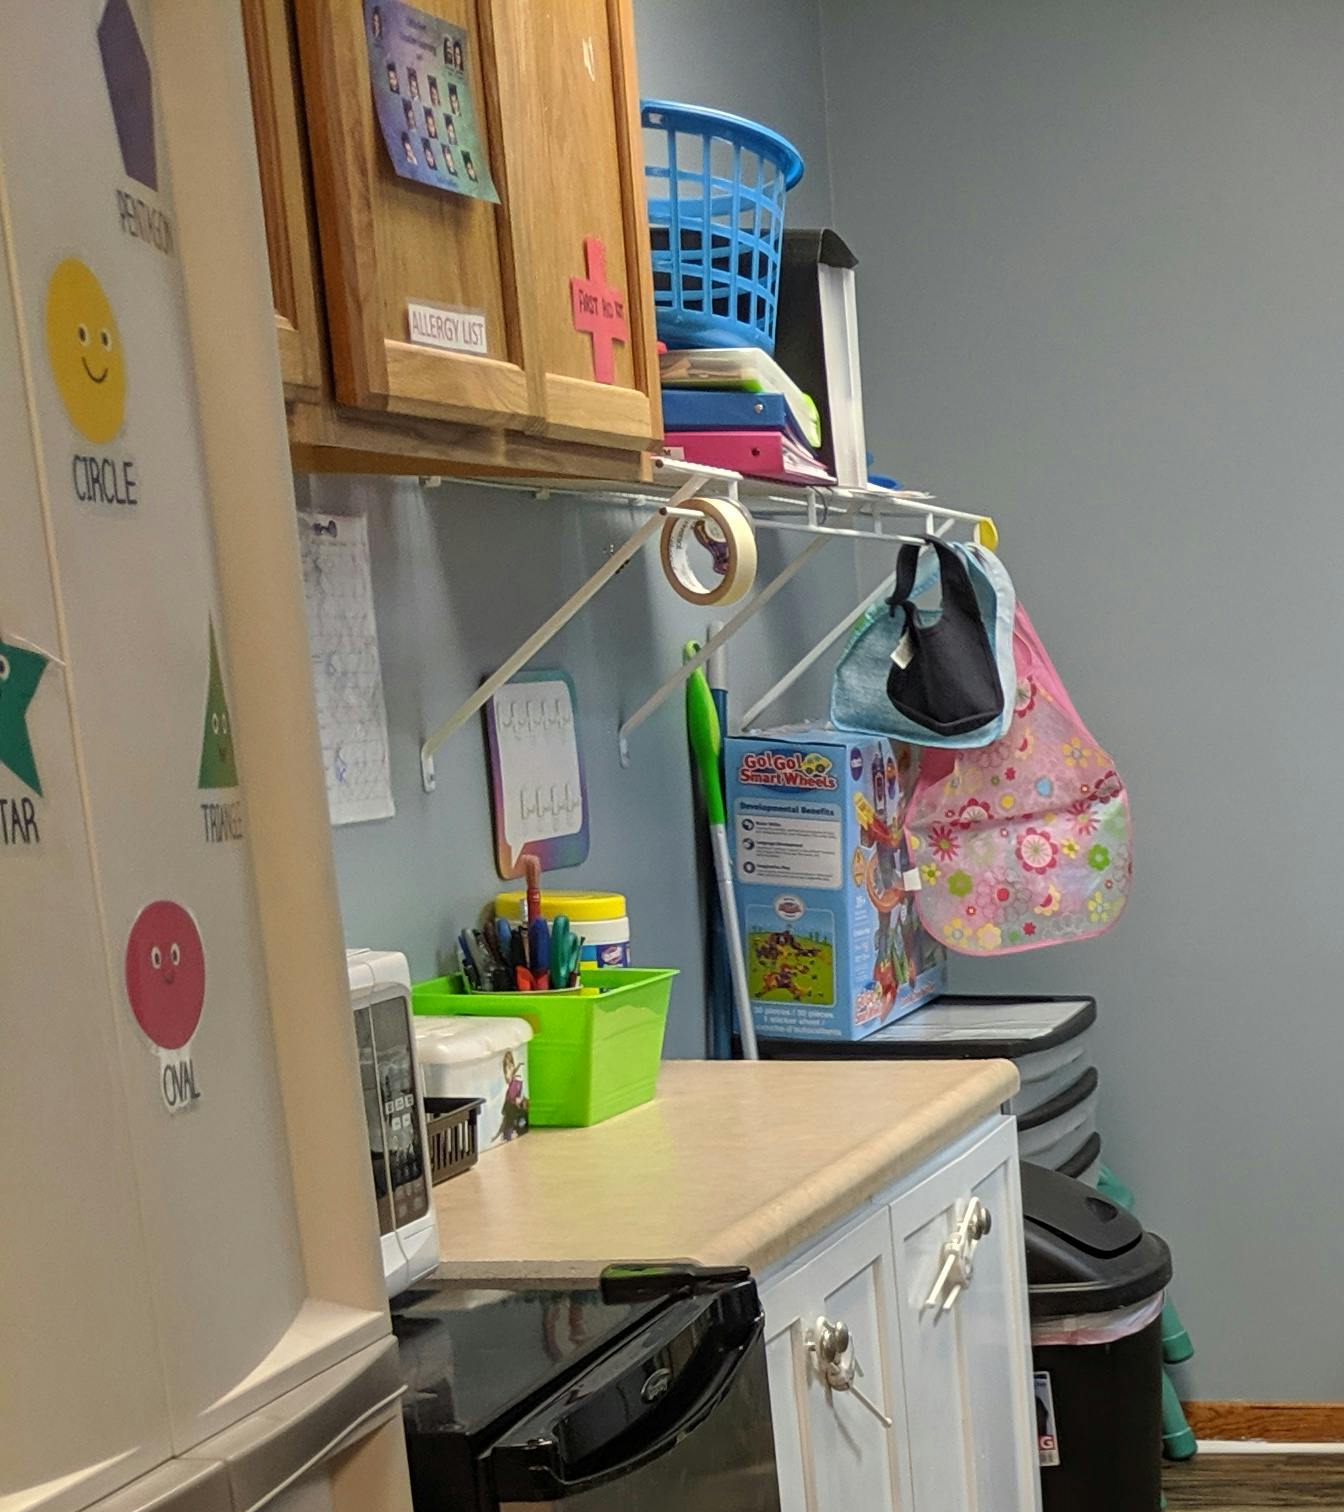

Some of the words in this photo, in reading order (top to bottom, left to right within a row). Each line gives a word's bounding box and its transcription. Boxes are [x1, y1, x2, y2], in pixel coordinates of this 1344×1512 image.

[411, 310, 460, 342] ALLERGY
[462, 319, 484, 346] LIST
[72, 454, 138, 505] CIRCLE
[744, 751, 772, 770] Go!
[773, 752, 802, 772] Go!
[739, 768, 782, 785] Smart
[783, 771, 838, 790] Wheels
[739, 801, 800, 816] Developmental
[800, 805, 835, 817] Benefits
[163, 1058, 201, 1107] OVAL
